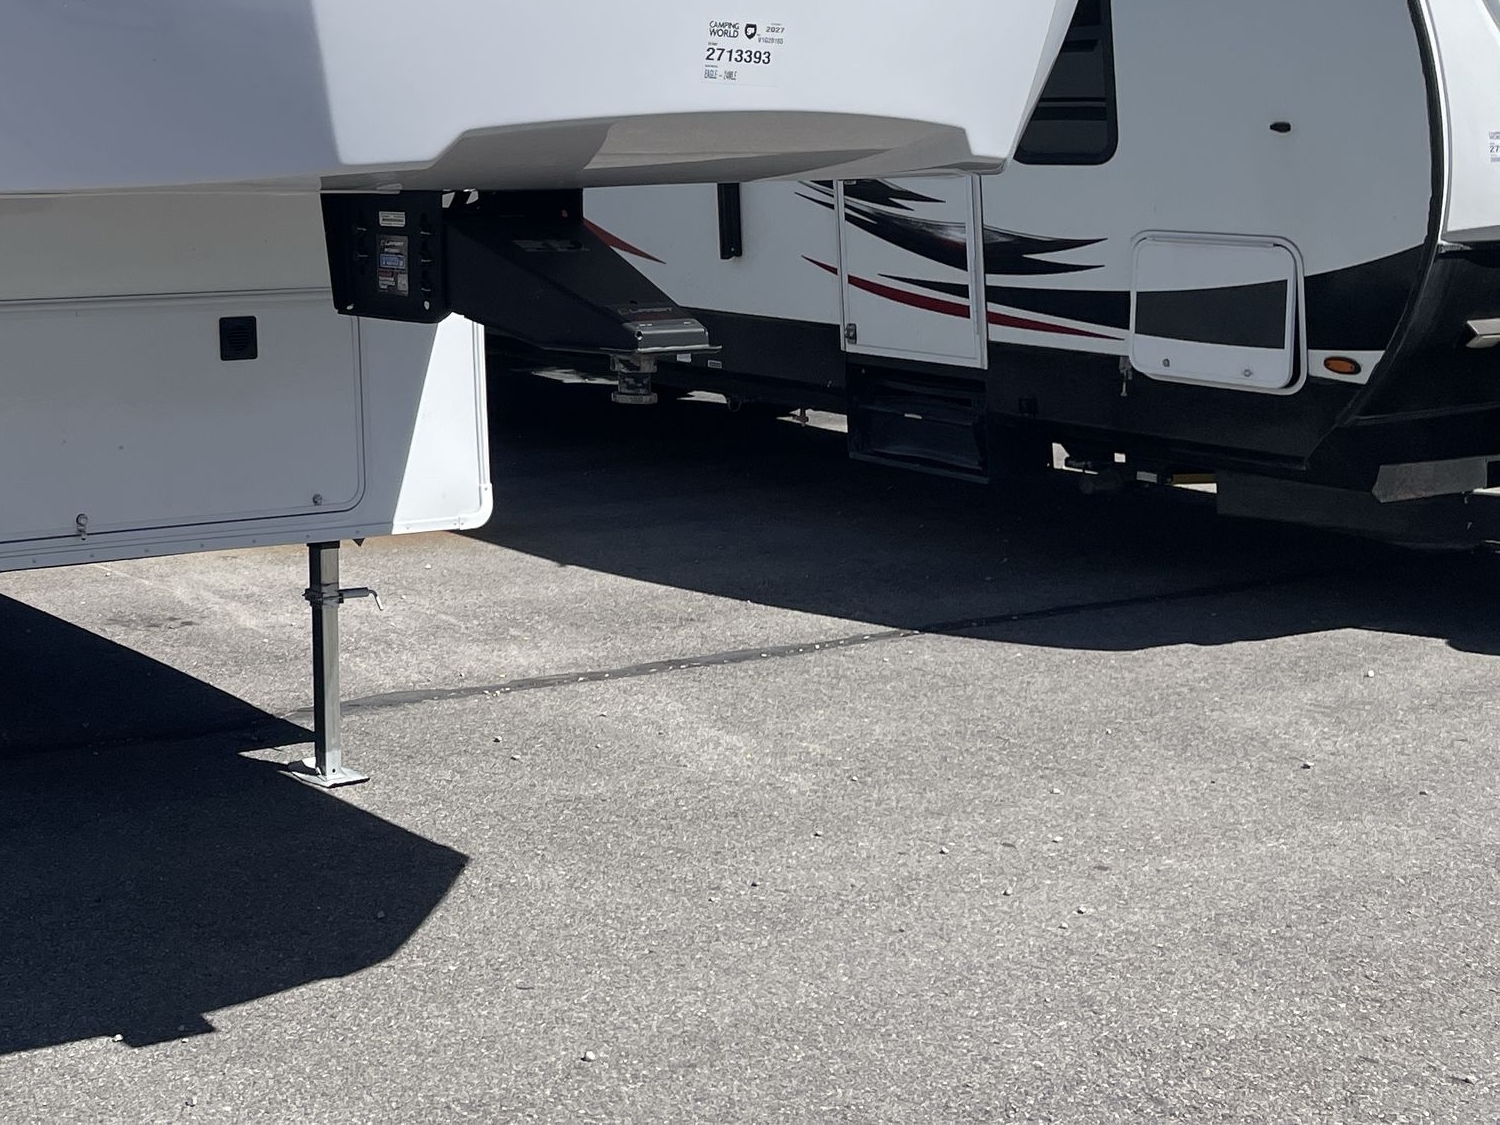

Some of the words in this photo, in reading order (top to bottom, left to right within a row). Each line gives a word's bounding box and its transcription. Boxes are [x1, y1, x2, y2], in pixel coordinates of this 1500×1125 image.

[709, 20, 740, 30] CAMPING
[709, 28, 740, 39] WORLD
[705, 47, 771, 65] 2713393
